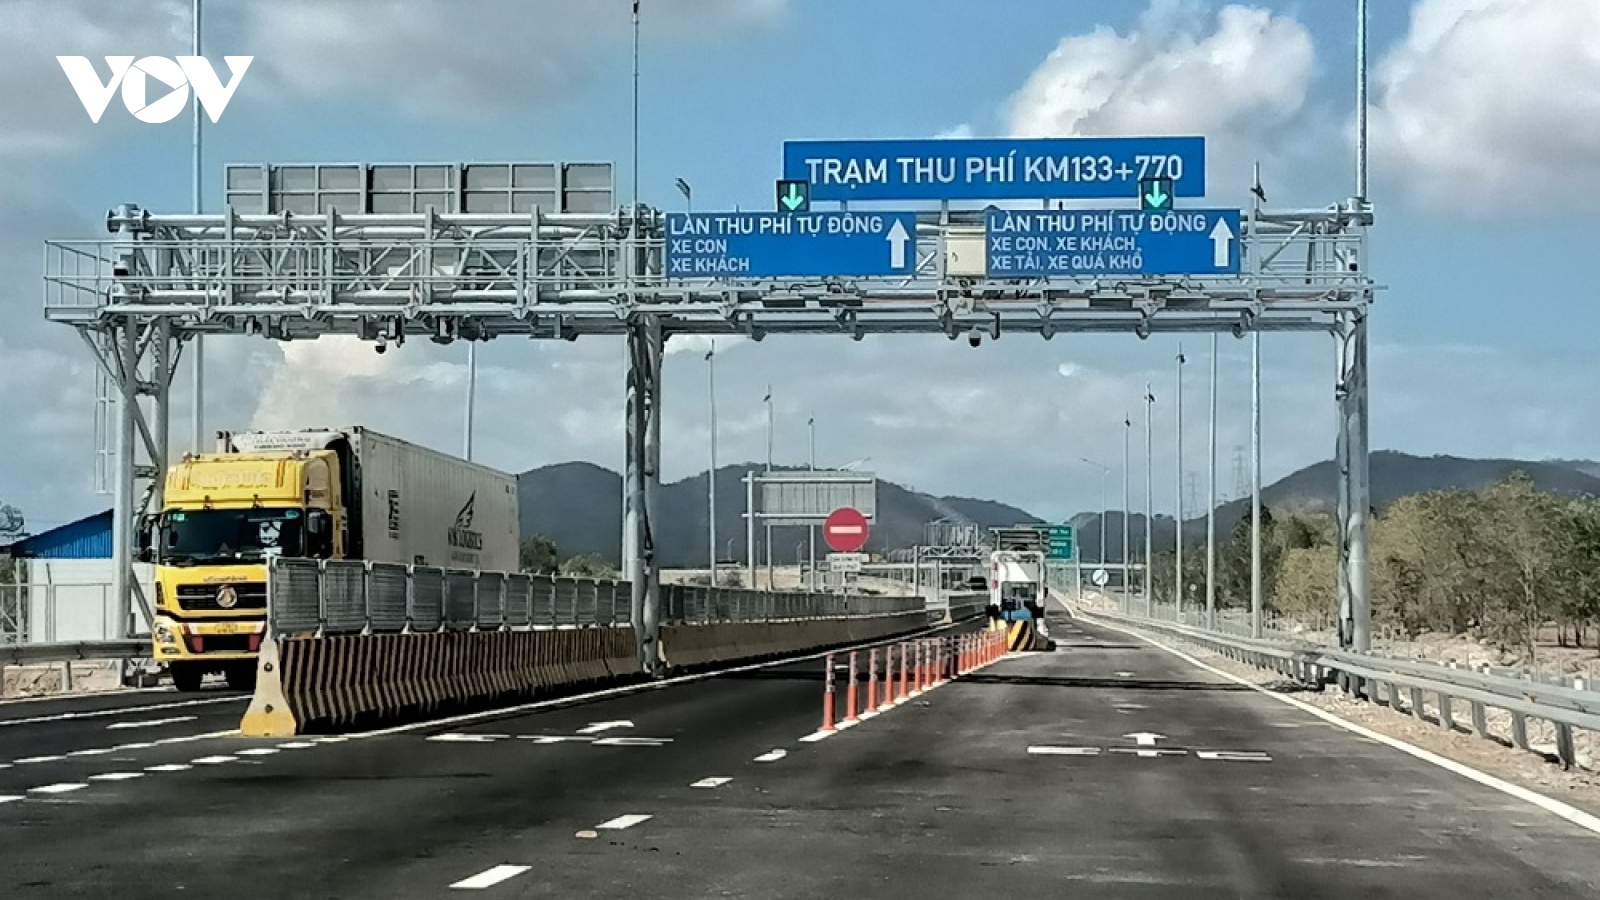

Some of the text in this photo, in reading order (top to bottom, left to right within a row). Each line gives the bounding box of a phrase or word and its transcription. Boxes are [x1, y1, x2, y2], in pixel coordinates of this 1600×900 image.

[805, 150, 1183, 190] TRẠM THU PHÍ KM133+770
[670, 212, 884, 238] LÀN THU PHÍ TỰ ĐỘNG
[991, 209, 1207, 236] LÀN THU PHÍ TỰ ĐỘNG
[671, 238, 728, 254] XE CON
[991, 236, 1011, 251] XE
[1056, 236, 1076, 251] XE
[671, 254, 750, 273] XE KHÁCH
[991, 255, 1011, 270] XE
[1047, 255, 1069, 270] XE
[1072, 251, 1105, 270] QUÁ
